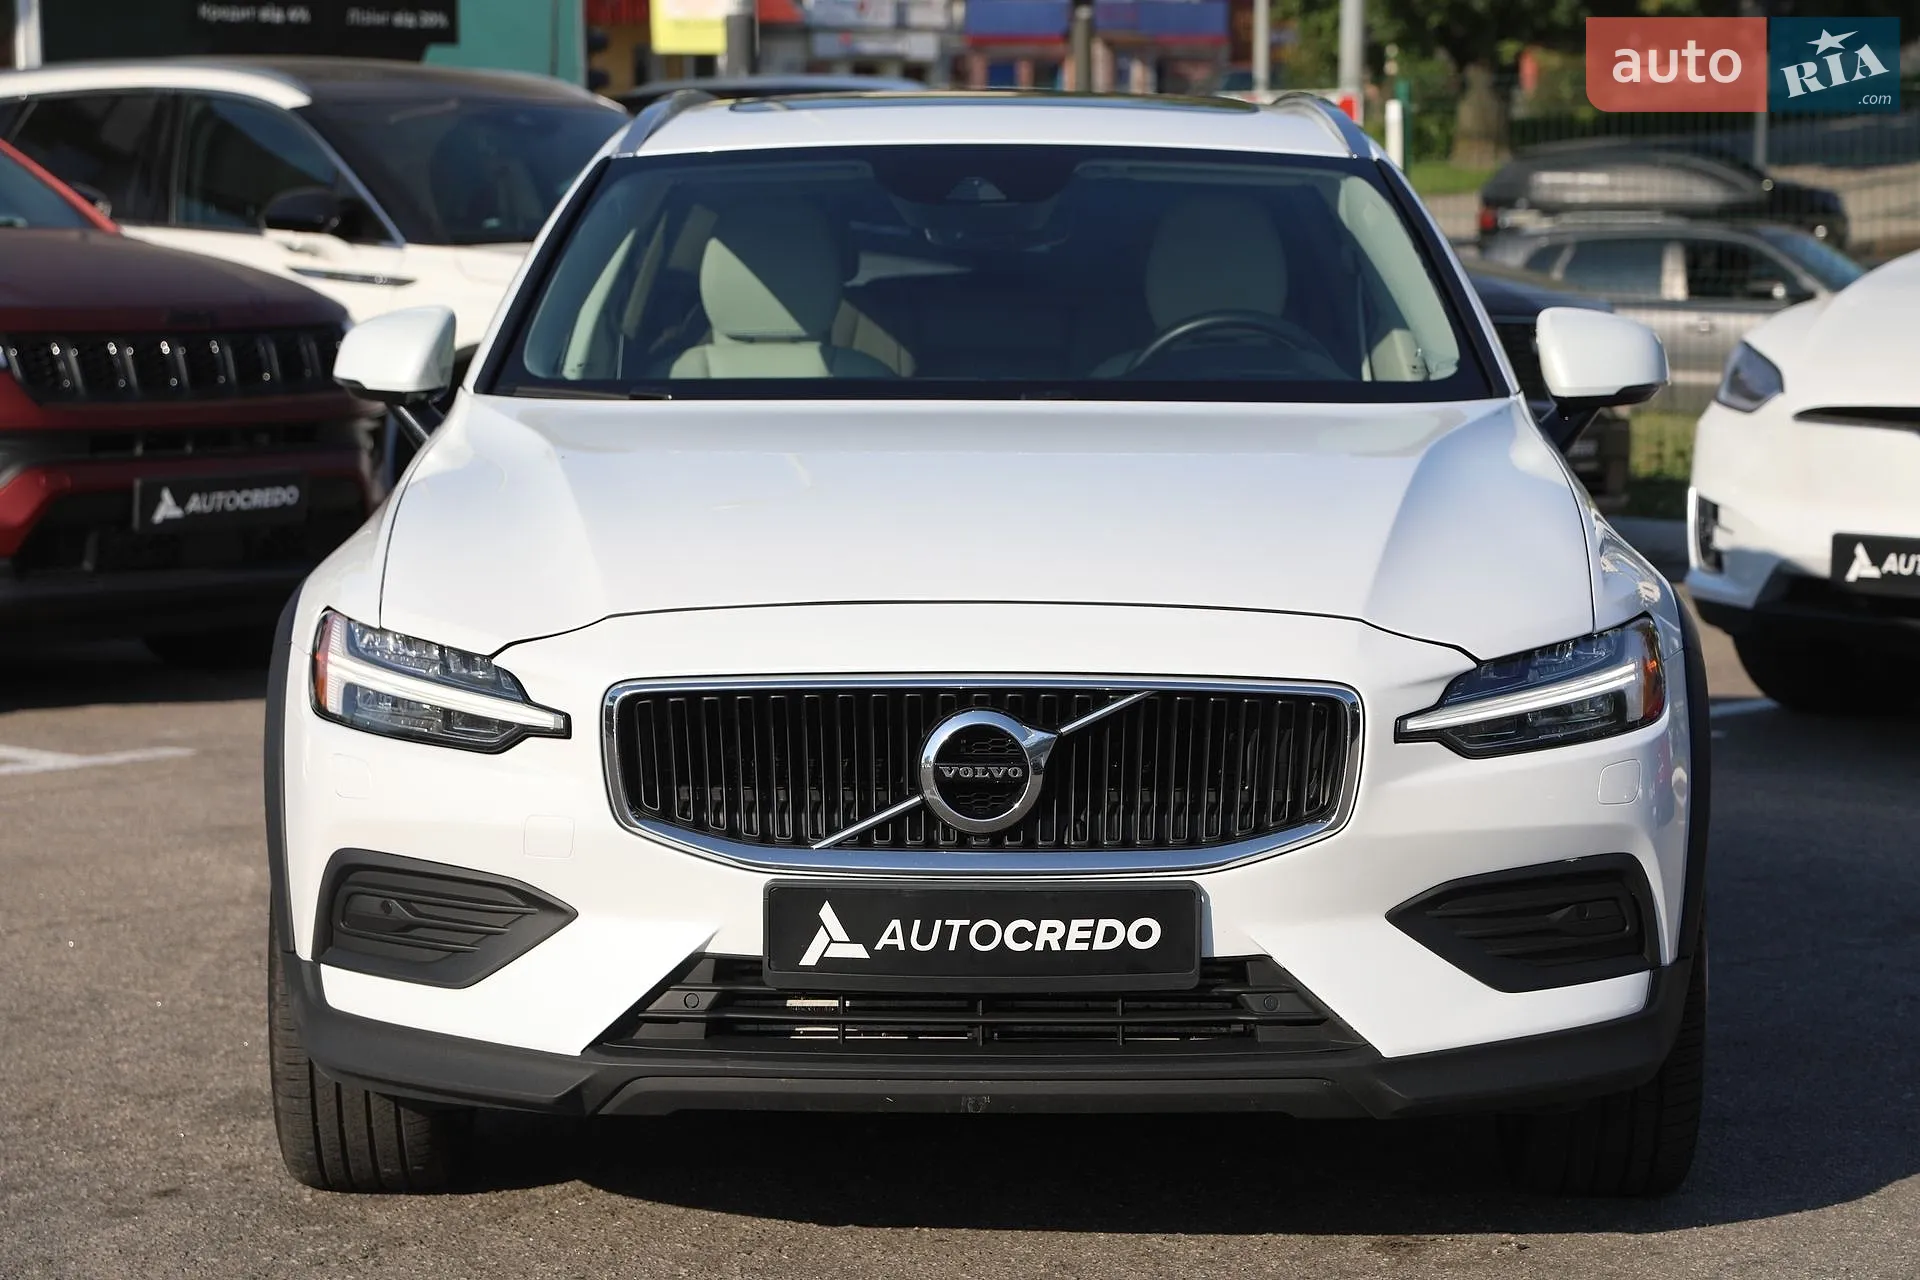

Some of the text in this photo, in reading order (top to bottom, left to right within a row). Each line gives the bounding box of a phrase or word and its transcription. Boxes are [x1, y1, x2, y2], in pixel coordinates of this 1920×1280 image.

[184, 484, 300, 515] AUTOCREDO
[1880, 552, 1920, 576] AU
[939, 766, 1023, 778] VOLVO
[873, 917, 1162, 951] AUTOCREDO
